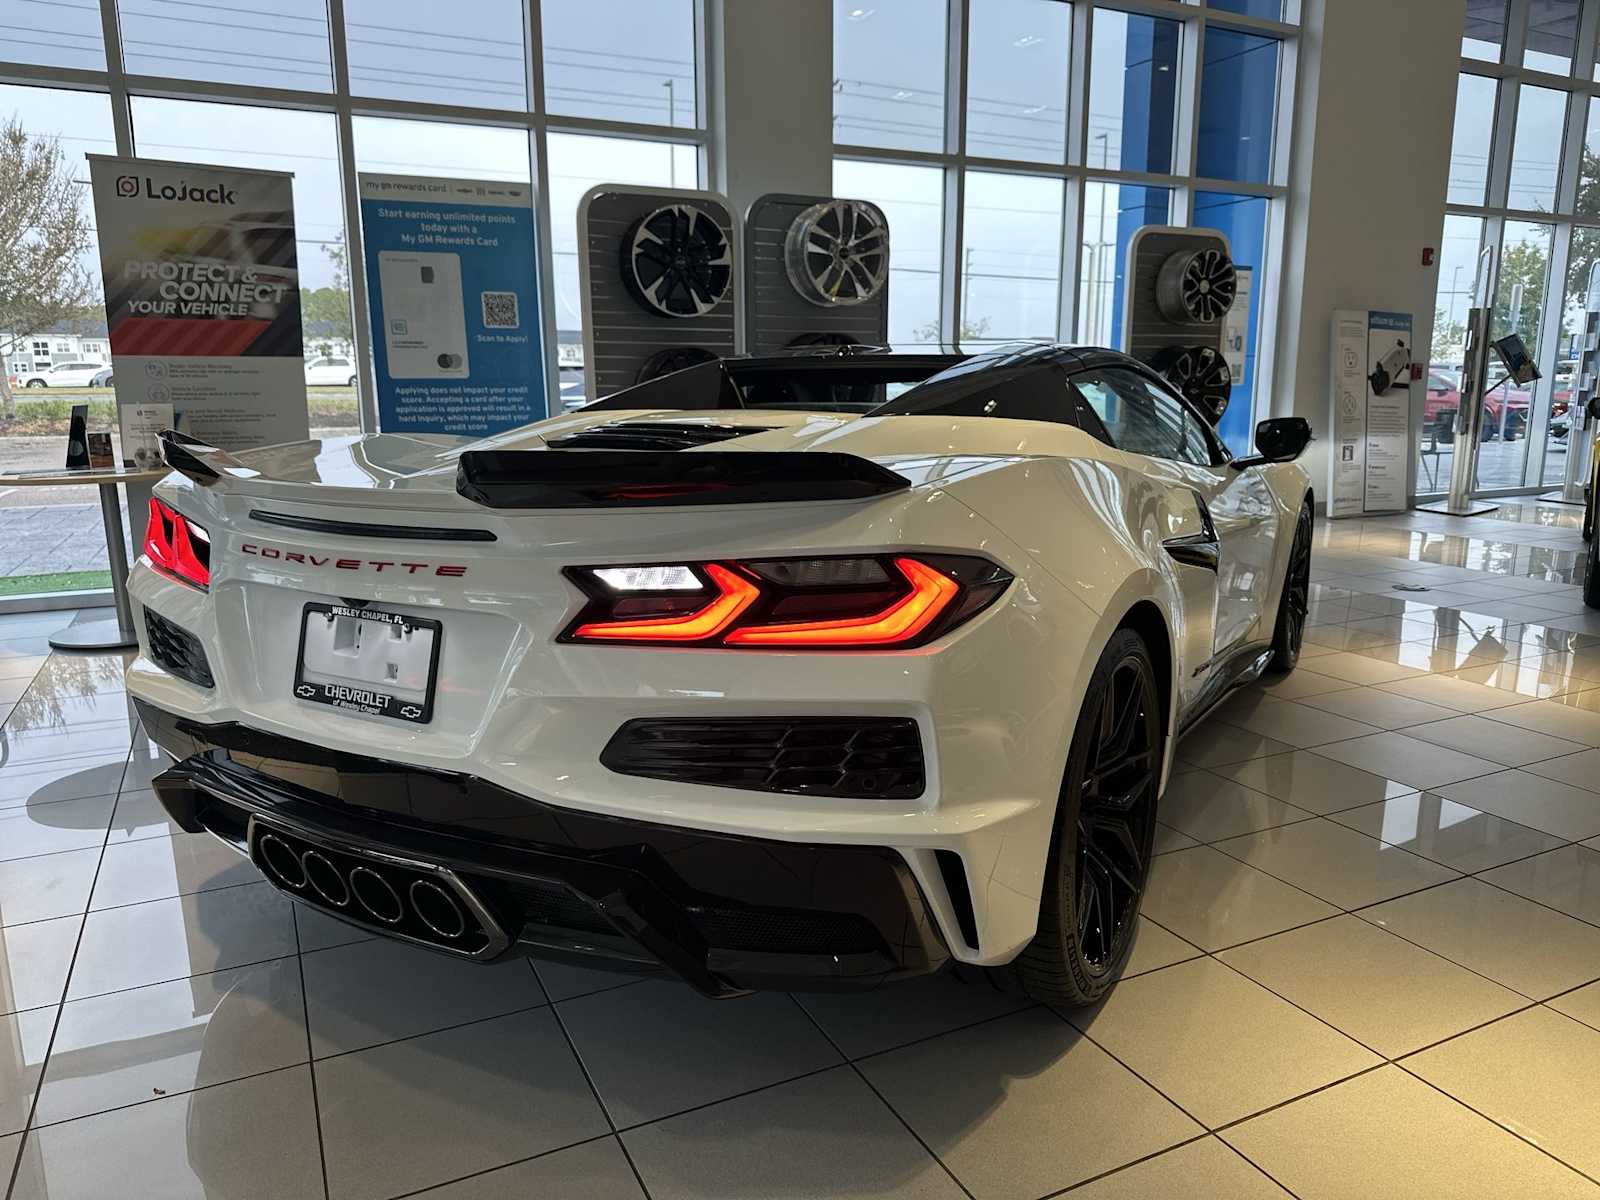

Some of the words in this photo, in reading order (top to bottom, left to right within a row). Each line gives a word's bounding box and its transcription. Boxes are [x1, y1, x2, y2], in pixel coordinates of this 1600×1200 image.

[393, 183, 426, 191] rewards
[428, 183, 447, 192] card
[377, 208, 403, 218] Start
[405, 210, 440, 221] earning
[442, 211, 486, 222] unlimited
[487, 213, 516, 224] points
[450, 223, 469, 233] with
[471, 226, 478, 234] a
[401, 233, 416, 245] My
[418, 234, 433, 244] GM
[434, 235, 474, 245] Rewards
[476, 236, 498, 247] Card
[124, 261, 241, 282] PROTECT
[241, 267, 257, 283] &
[159, 280, 287, 304] CONNECT
[128, 299, 176, 315] YOUR
[180, 302, 248, 316] VEHICLE
[395, 386, 429, 395] Applying
[430, 386, 448, 394] does
[490, 387, 505, 395] your
[242, 543, 468, 577] CORVETTE
[332, 606, 360, 617] WESLEY
[361, 610, 393, 624] CHAPEL,
[394, 615, 404, 624] FL
[325, 684, 391, 709] CHEVROLET
